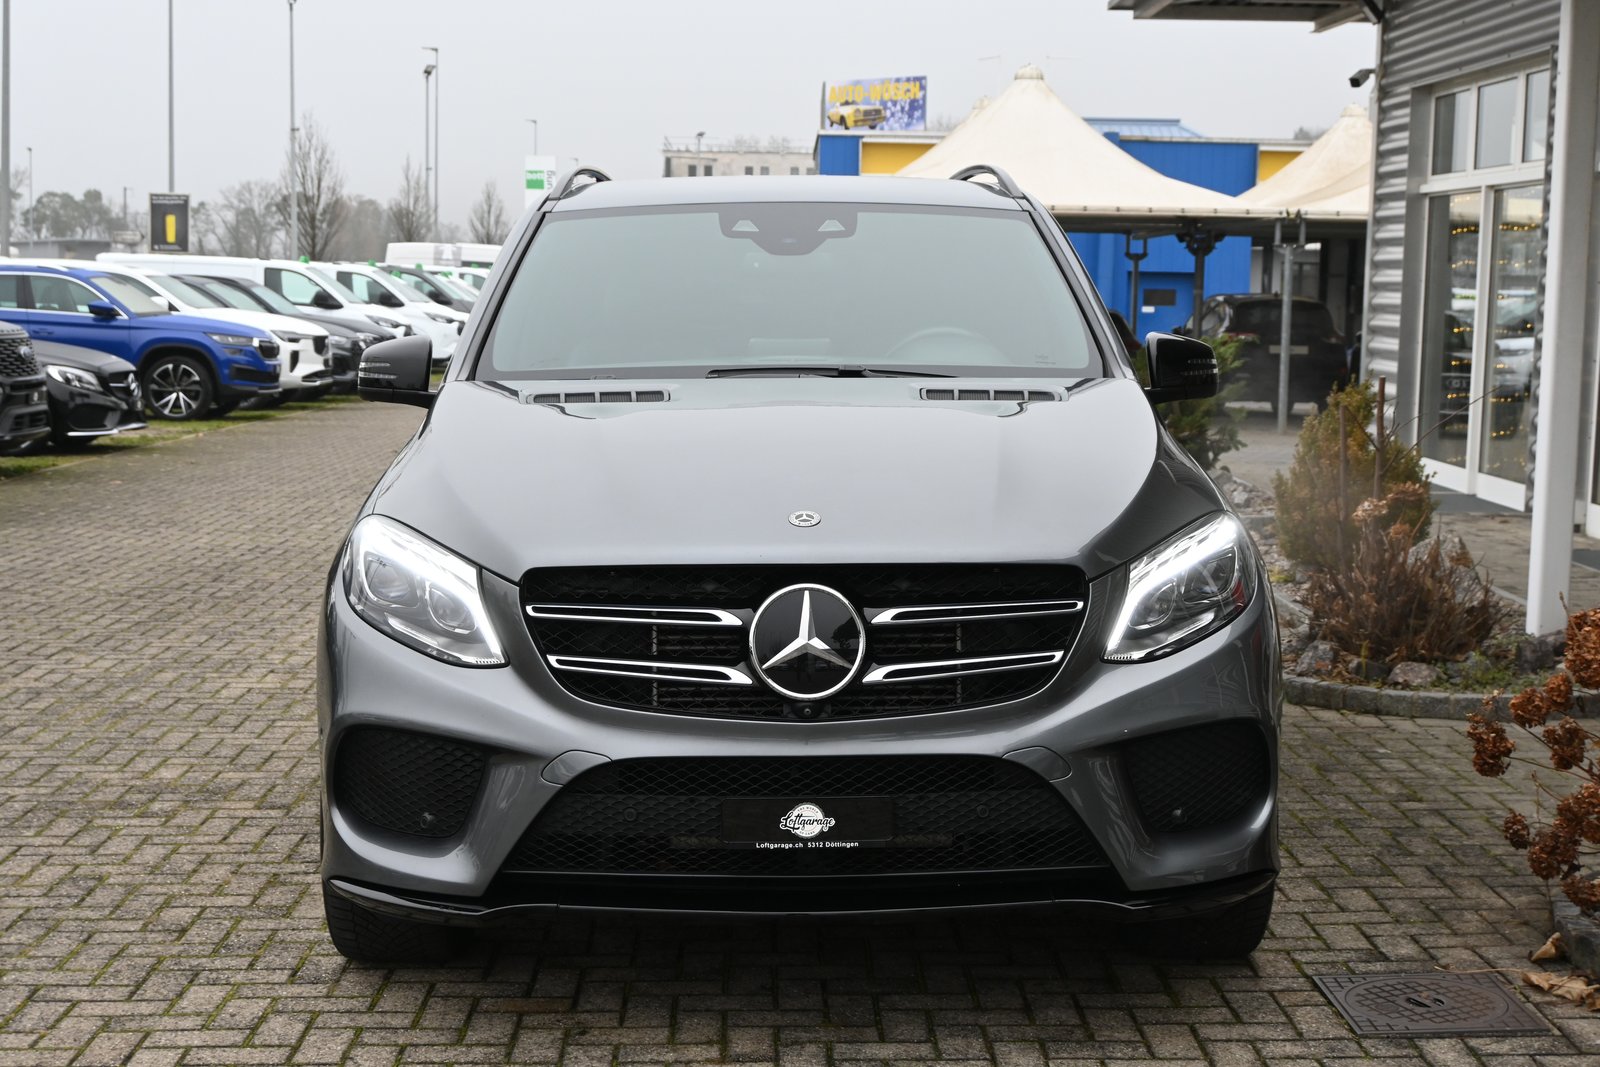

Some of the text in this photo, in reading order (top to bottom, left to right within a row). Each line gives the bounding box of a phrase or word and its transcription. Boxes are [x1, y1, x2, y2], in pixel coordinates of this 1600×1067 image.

[829, 80, 920, 103] AUTO-WÖSCH
[781, 811, 834, 832] Loftgarage
[825, 841, 859, 849] Döttingen
